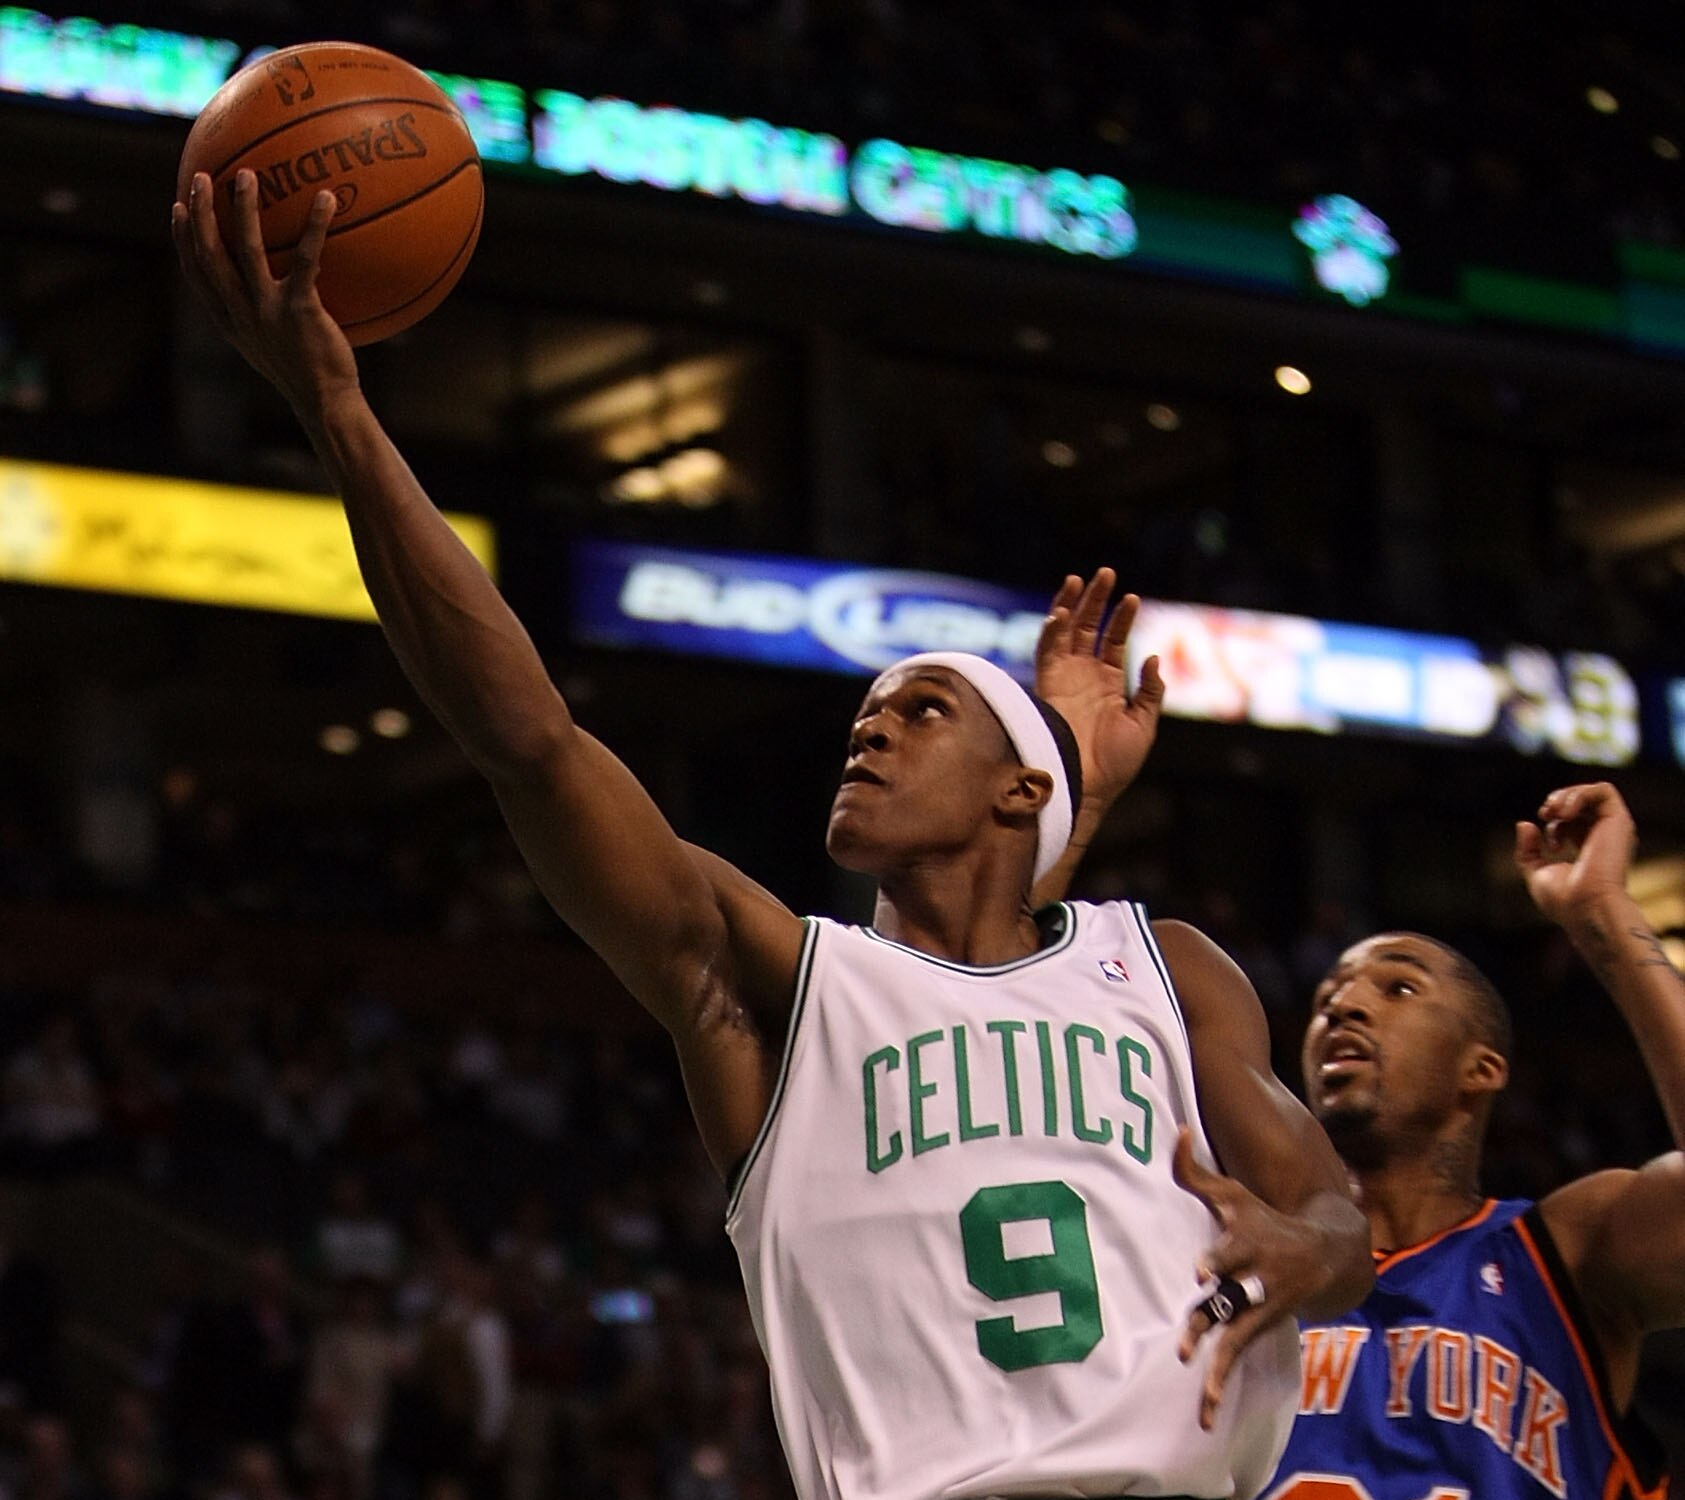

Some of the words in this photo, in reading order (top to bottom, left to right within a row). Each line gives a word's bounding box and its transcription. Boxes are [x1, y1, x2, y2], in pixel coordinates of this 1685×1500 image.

[863, 1020, 1153, 1174] CELTICS
[959, 1180, 1104, 1373] 9
[1385, 1325, 1569, 1500] YORK
